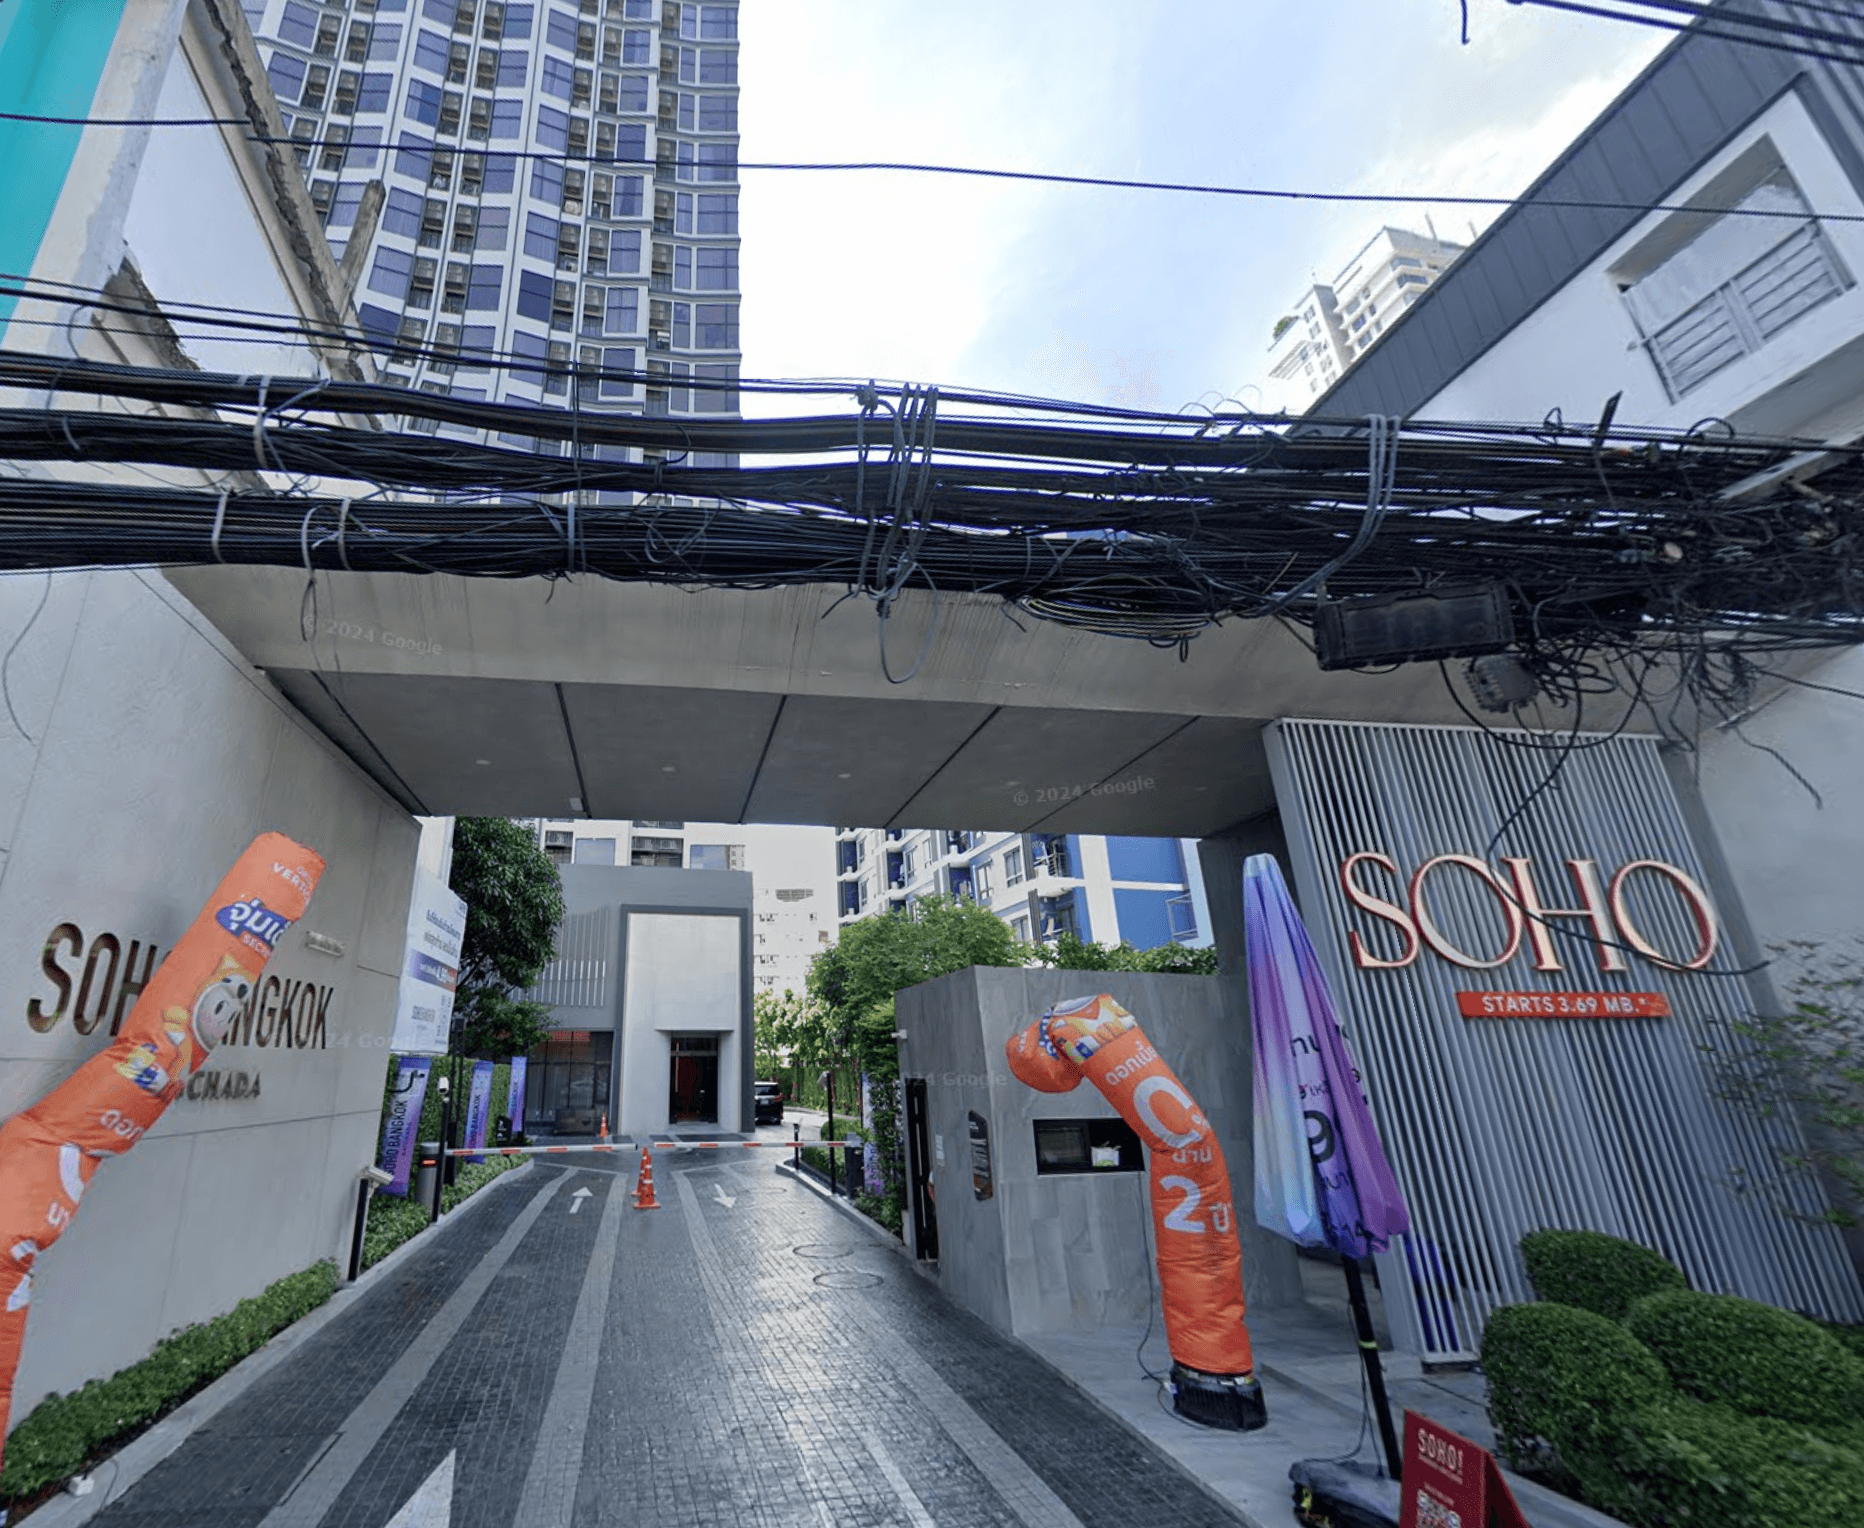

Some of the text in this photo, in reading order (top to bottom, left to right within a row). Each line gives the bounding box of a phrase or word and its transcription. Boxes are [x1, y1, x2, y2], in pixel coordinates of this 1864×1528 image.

[1341, 852, 1717, 971] SOHO
[27, 921, 171, 1037] SOH
[221, 974, 334, 1050] NGKOK
[1482, 995, 1555, 1013] STARTS
[1558, 996, 1598, 1013] 3.69
[184, 1070, 261, 1101] CHADA
[1159, 1174, 1205, 1233] 2
